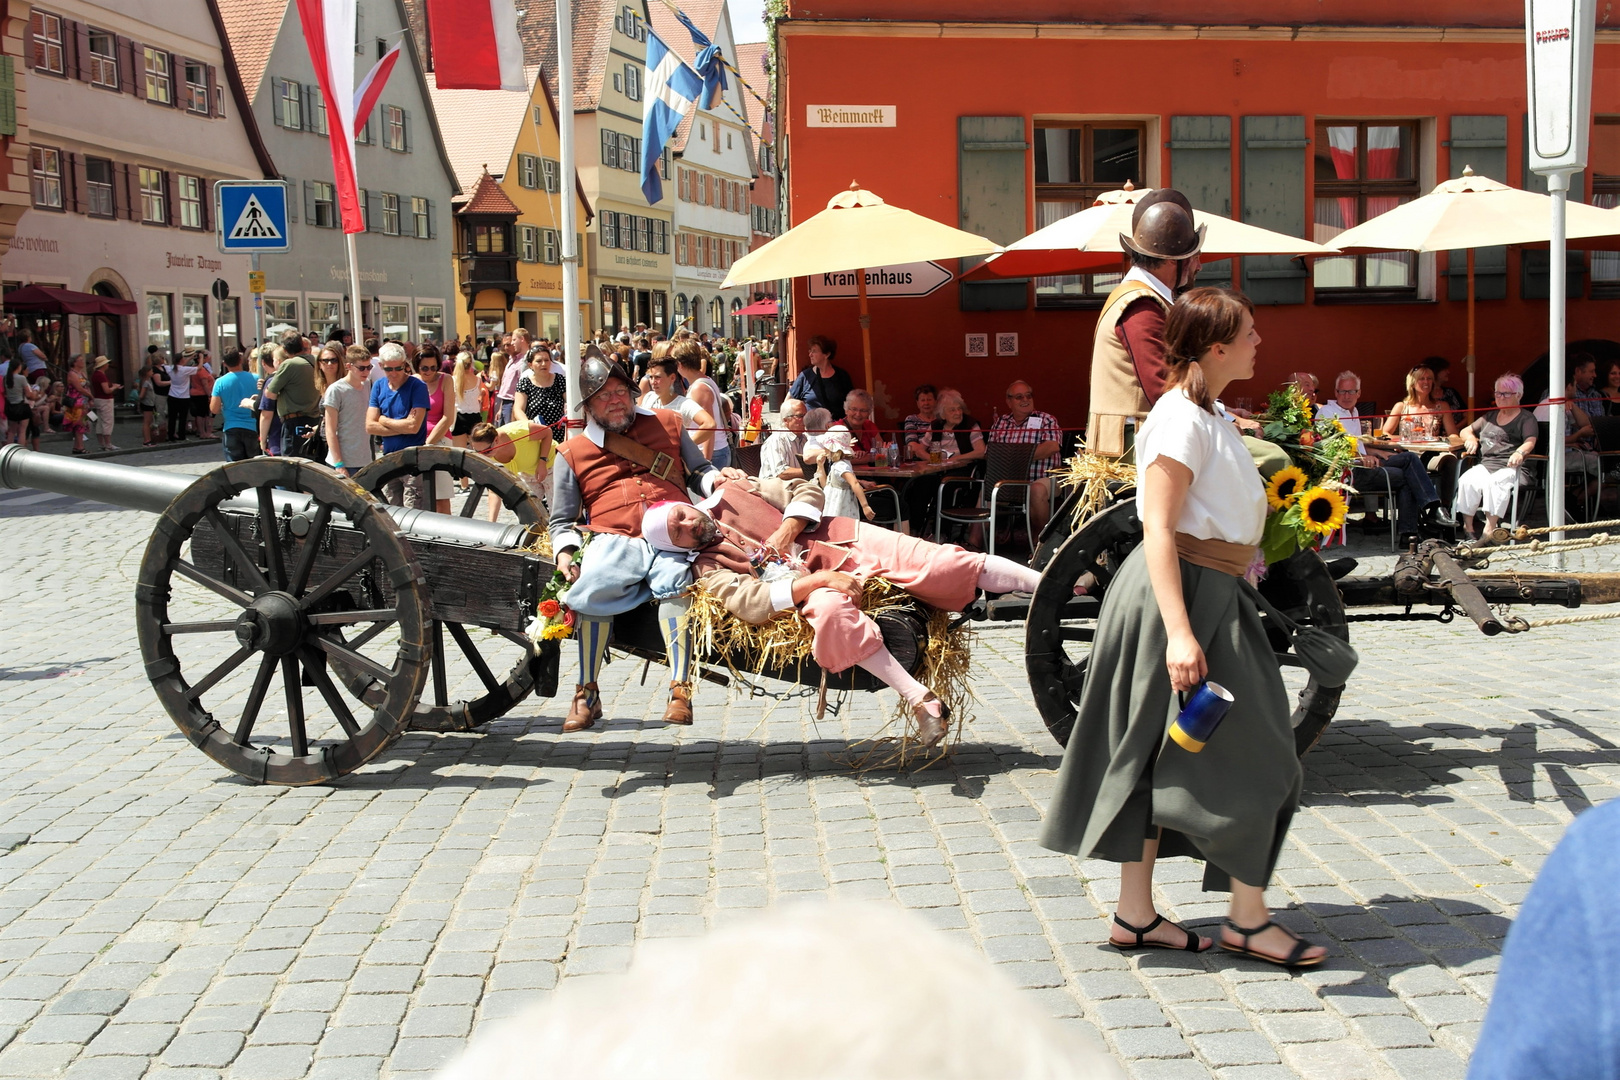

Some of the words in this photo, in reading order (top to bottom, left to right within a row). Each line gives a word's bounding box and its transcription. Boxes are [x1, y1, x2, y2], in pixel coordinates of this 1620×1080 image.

[817, 108, 884, 124] Weinmarkt
[166, 251, 194, 268] Juwelier
[197, 255, 222, 273] Dragon
[824, 268, 913, 286] Kranenhaus
